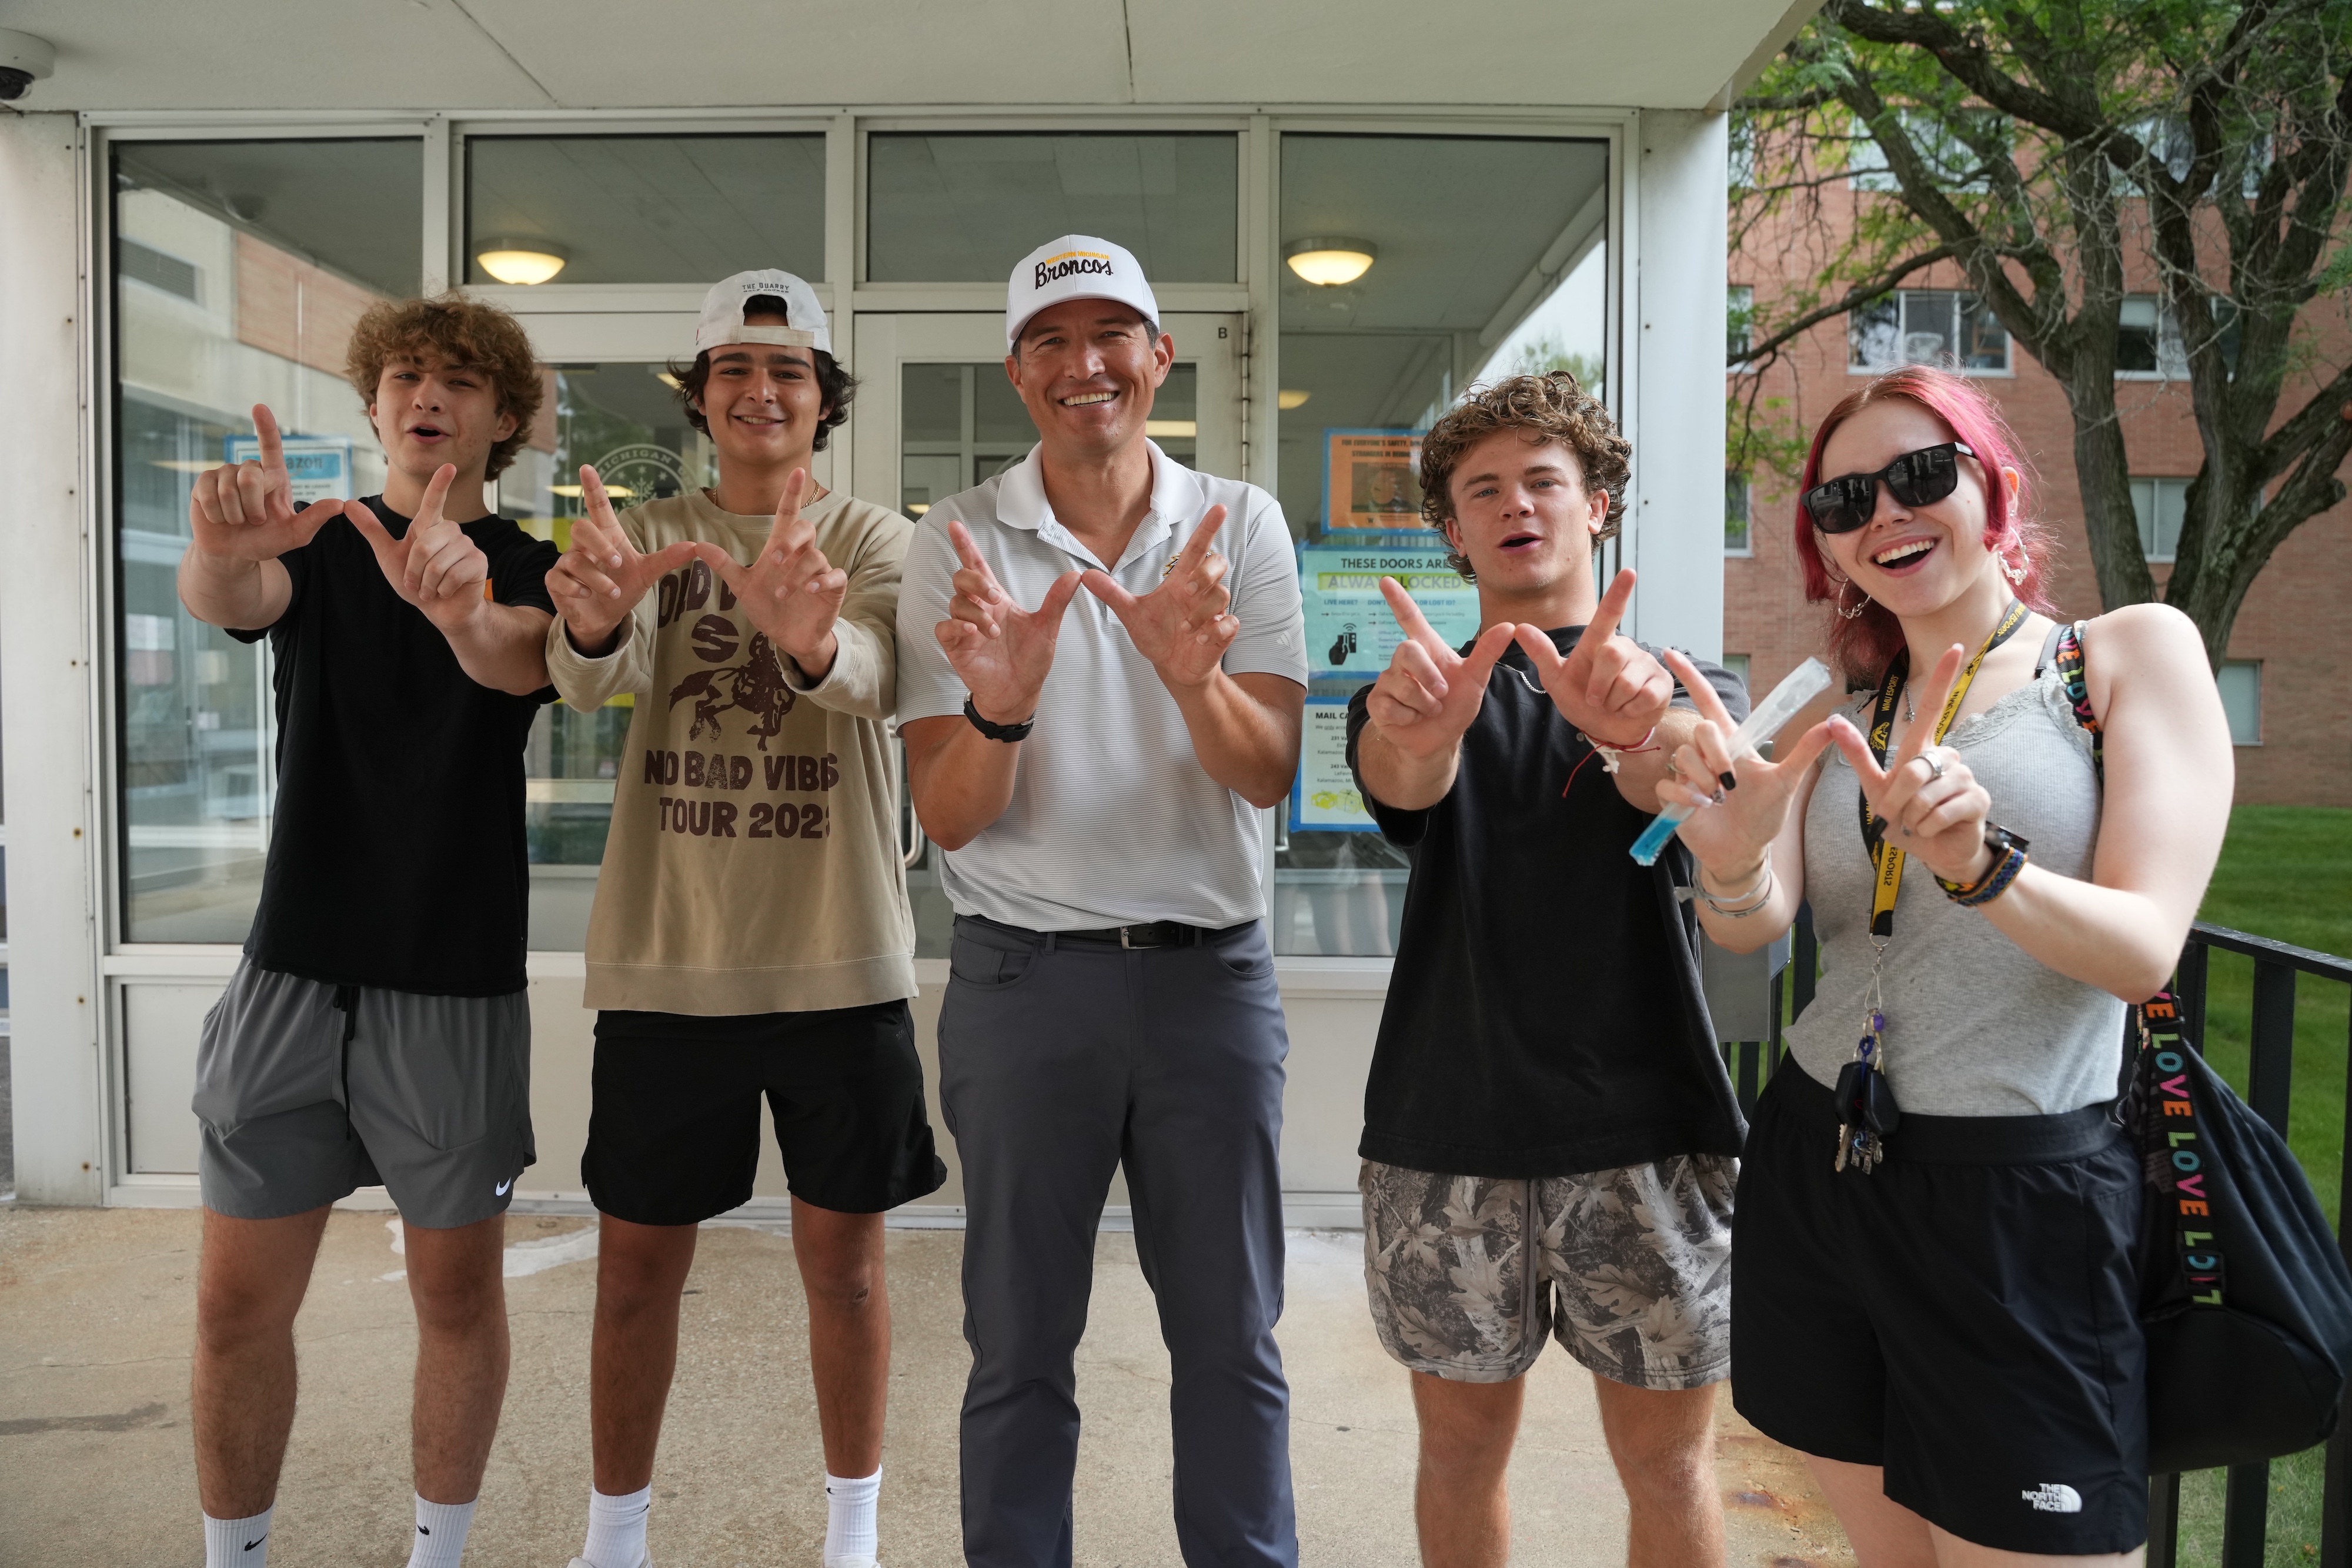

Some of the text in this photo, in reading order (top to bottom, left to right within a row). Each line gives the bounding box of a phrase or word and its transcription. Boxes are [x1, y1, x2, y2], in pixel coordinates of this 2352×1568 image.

[1046, 251, 1110, 265] WESTERN MICHIGAN
[1035, 259, 1113, 289] Broncos
[759, 282, 789, 290] QUARRY
[1218, 327, 1227, 339] B
[286, 456, 323, 469] azon
[1341, 558, 1377, 569] THESE
[1380, 558, 1422, 569] DOORS
[1400, 576, 1462, 589] LOCKED
[1882, 674, 1899, 711] WMU ESPORTS
[644, 750, 679, 785] NO
[684, 751, 753, 790] BAD
[660, 797, 830, 838] TOUR 202
[2151, 1033, 2193, 1116] LOVE
[2168, 1131, 2210, 1216] LOVE
[2039, 1483, 2060, 1493] THE
[2022, 1490, 2061, 1502] NORTH
[2033, 1500, 2062, 1513] FACE
